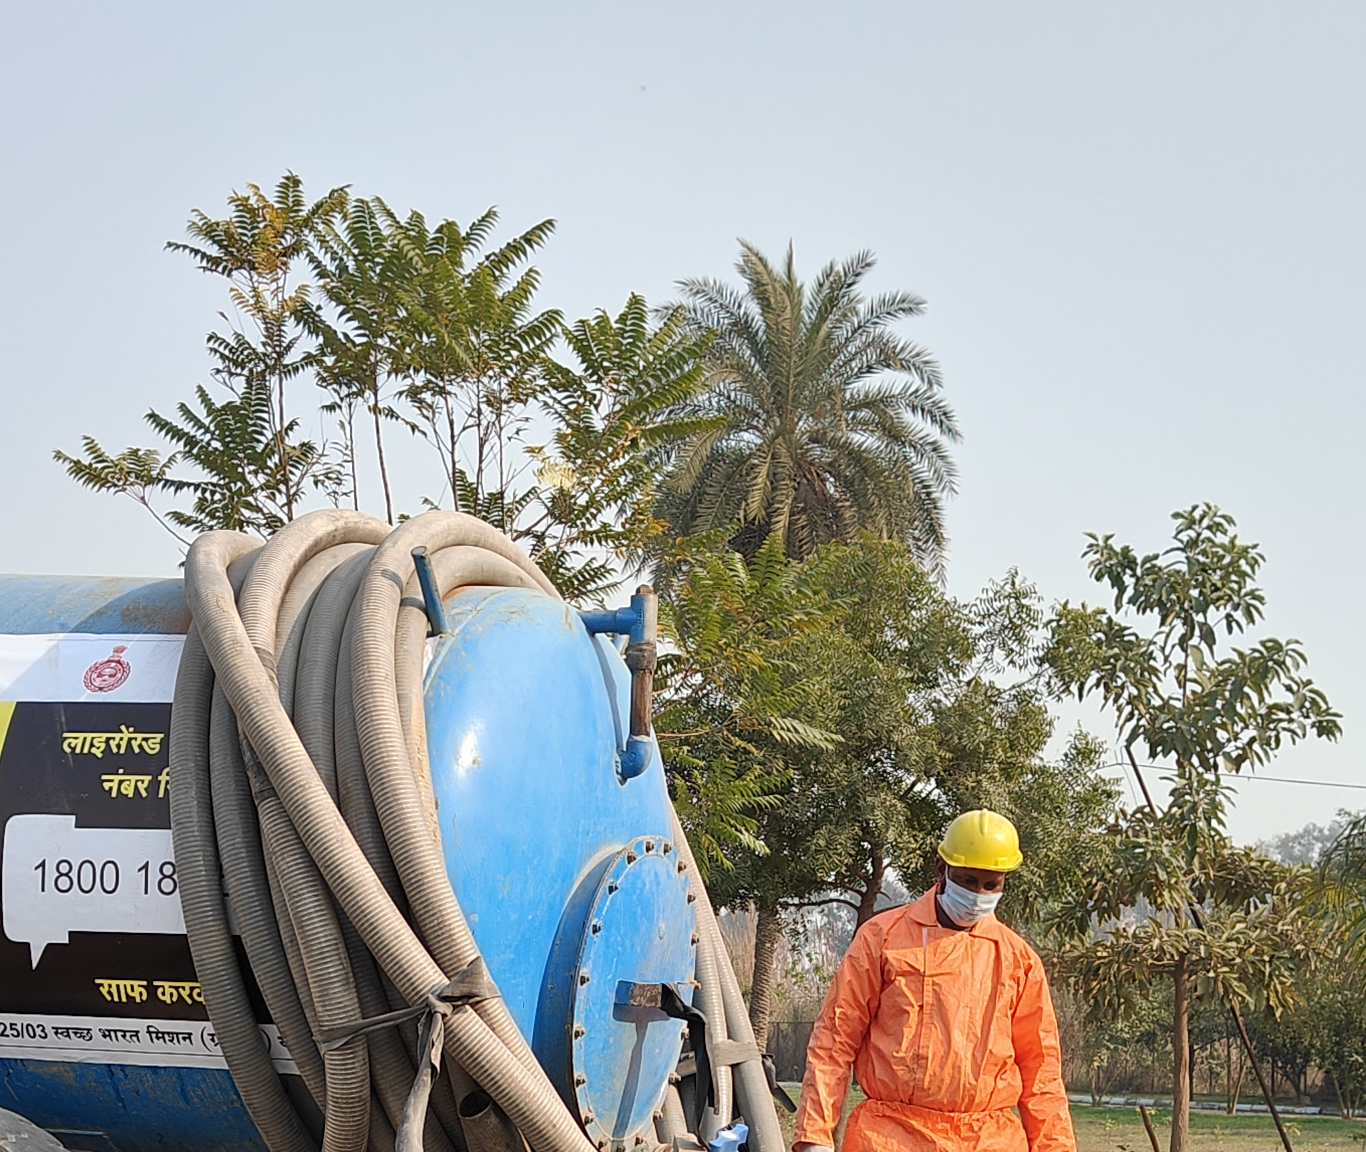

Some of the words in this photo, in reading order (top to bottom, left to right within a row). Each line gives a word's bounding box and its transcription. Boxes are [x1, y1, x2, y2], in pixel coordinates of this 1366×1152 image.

[101, 768, 153, 798] नंबर
[33, 858, 120, 895] 1800
[137, 860, 178, 896] 18
[94, 978, 147, 1003] साफ
[152, 980, 206, 1005] करव
[52, 1026, 92, 1042] स्वच्छ
[99, 1027, 140, 1044] भारत
[146, 1025, 193, 1046] मिशन
